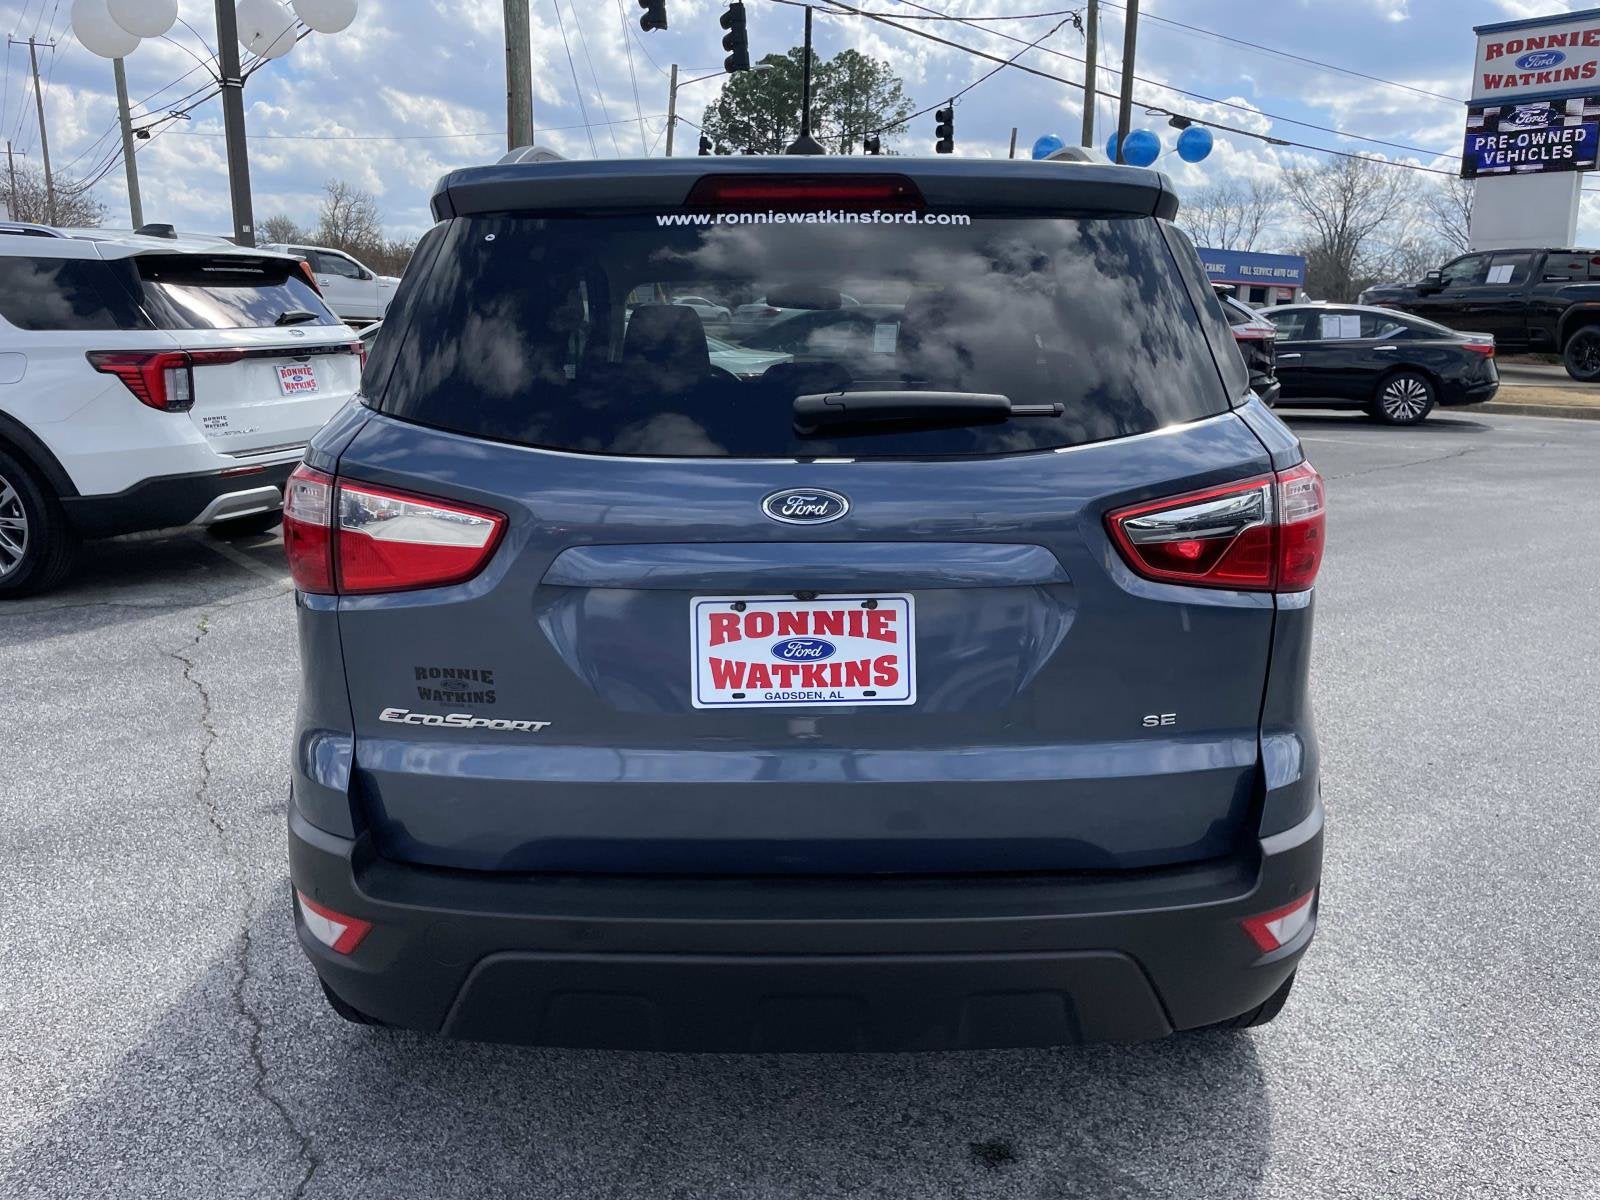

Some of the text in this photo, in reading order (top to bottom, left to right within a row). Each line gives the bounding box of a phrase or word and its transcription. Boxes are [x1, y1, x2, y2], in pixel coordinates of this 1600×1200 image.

[1485, 28, 1600, 61] RONNIE
[1484, 60, 1597, 90] WATKINS
[1515, 110, 1549, 124] Ford
[1474, 128, 1587, 151] PRE-OWNED
[1484, 145, 1573, 165] VEHICLES
[656, 209, 971, 226] www.ronniewatkinsford.com
[1240, 265, 1299, 279] FULL SERVICE AUTO CARE
[280, 366, 314, 380] RONNIE
[284, 379, 317, 391] WATKINS
[782, 495, 828, 515] Ford
[709, 609, 897, 647] RONNIE
[784, 641, 822, 658] Ford
[414, 666, 494, 685] RONNIE
[709, 654, 899, 689] WATKINS
[417, 686, 496, 704] WATKINS
[764, 690, 845, 701] GADSDEN, AL
[1142, 713, 1176, 727] SE
